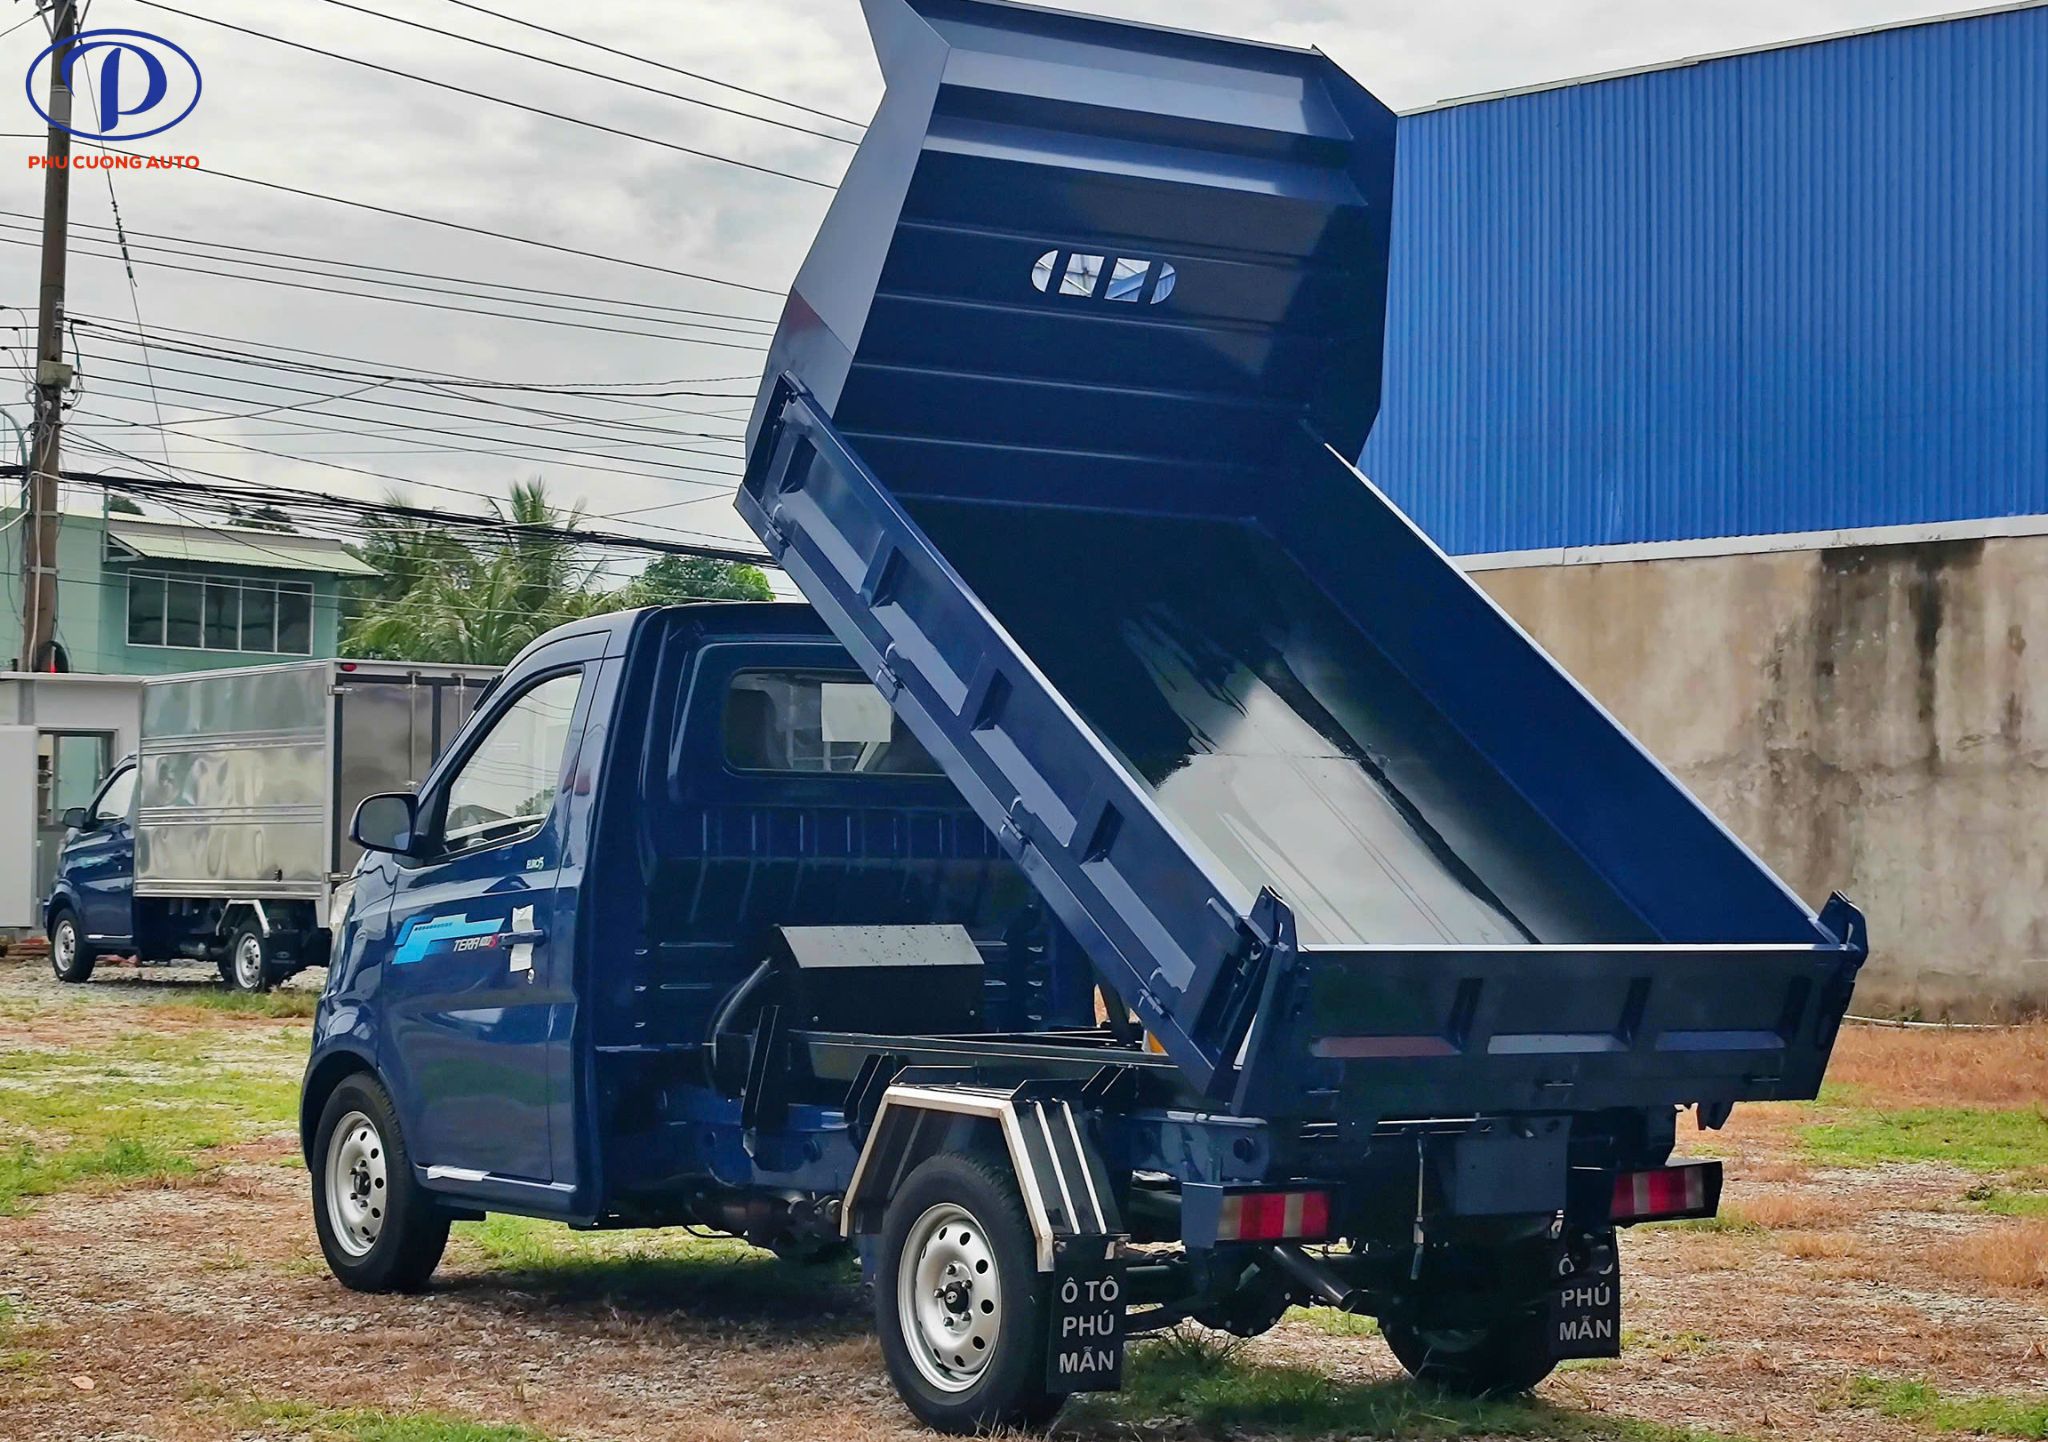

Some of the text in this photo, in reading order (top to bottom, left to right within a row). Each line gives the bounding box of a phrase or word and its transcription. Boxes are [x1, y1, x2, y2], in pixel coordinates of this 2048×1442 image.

[453, 937, 480, 952] TERA
[1061, 1275, 1119, 1303] Ô TÔ
[1561, 1282, 1611, 1308] PHÚ
[1062, 1309, 1115, 1338] PHÚ
